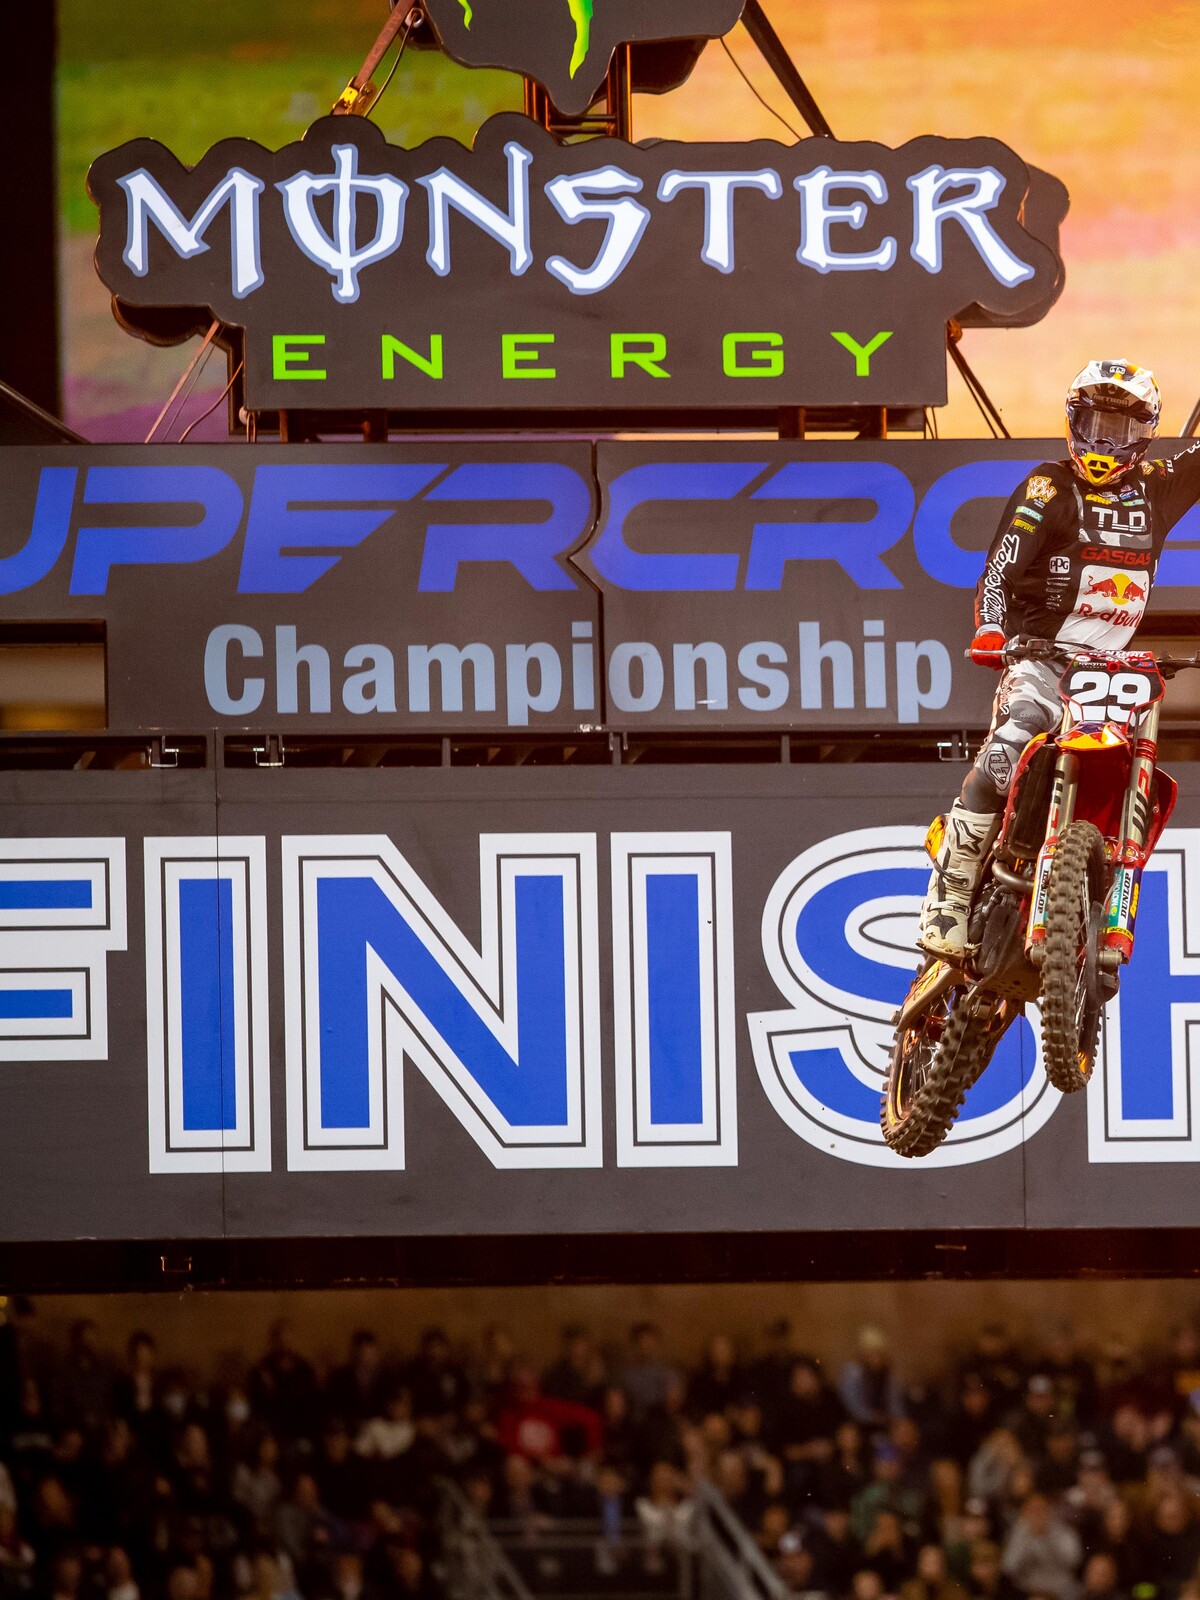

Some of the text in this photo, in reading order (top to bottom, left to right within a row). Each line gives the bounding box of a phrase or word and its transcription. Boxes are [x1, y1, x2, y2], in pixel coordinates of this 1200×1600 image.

[115, 142, 1037, 304] MONSTER
[273, 331, 893, 379] ENERGY
[1091, 506, 1145, 532] TLD
[1050, 557, 1069, 572] PPG
[1077, 603, 1118, 622] Red
[203, 621, 952, 725] Championship
[1068, 671, 1151, 727] 29
[1121, 872, 1132, 919] DUNLOP
